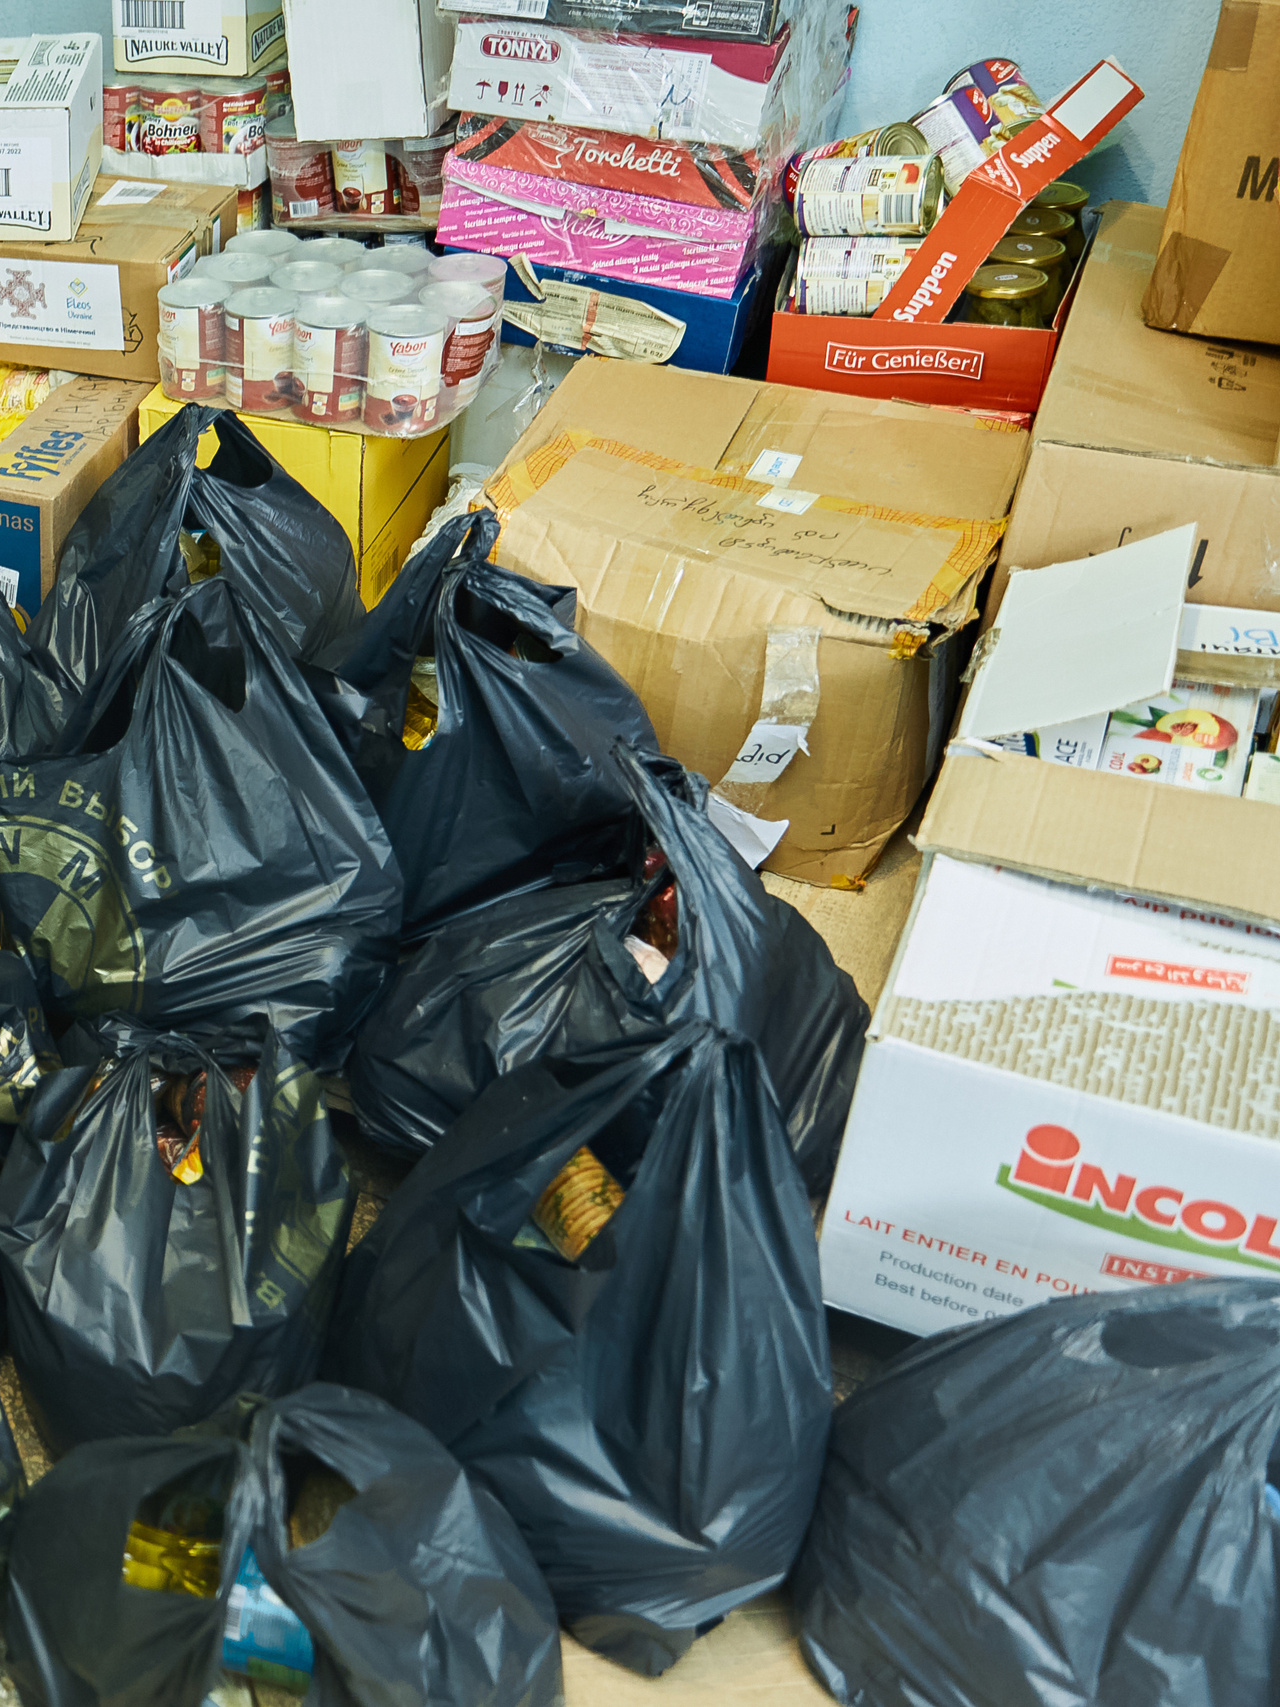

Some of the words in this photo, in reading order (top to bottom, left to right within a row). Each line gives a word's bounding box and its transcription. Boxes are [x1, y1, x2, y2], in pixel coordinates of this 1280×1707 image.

[488, 37, 553, 61] TONIYA
[148, 124, 198, 138] Bohnen
[573, 136, 682, 177] Torchetti
[1010, 132, 1061, 168] Suppen
[893, 251, 958, 323] Suppen
[66, 297, 92, 311] Eleos
[389, 340, 428, 357] Yabon
[832, 349, 866, 369] Für
[871, 350, 980, 373] Genießer!
[844, 1209, 896, 1236] LAIT
[902, 1229, 988, 1266] ENTIER
[995, 1258, 1029, 1279] EN
[1035, 1272, 1099, 1296] POU
[879, 1250, 977, 1293] Production
[982, 1285, 1024, 1307] date
[1111, 1260, 1195, 1282] INST
[873, 1272, 915, 1297] Best
[920, 1288, 979, 1317] before
